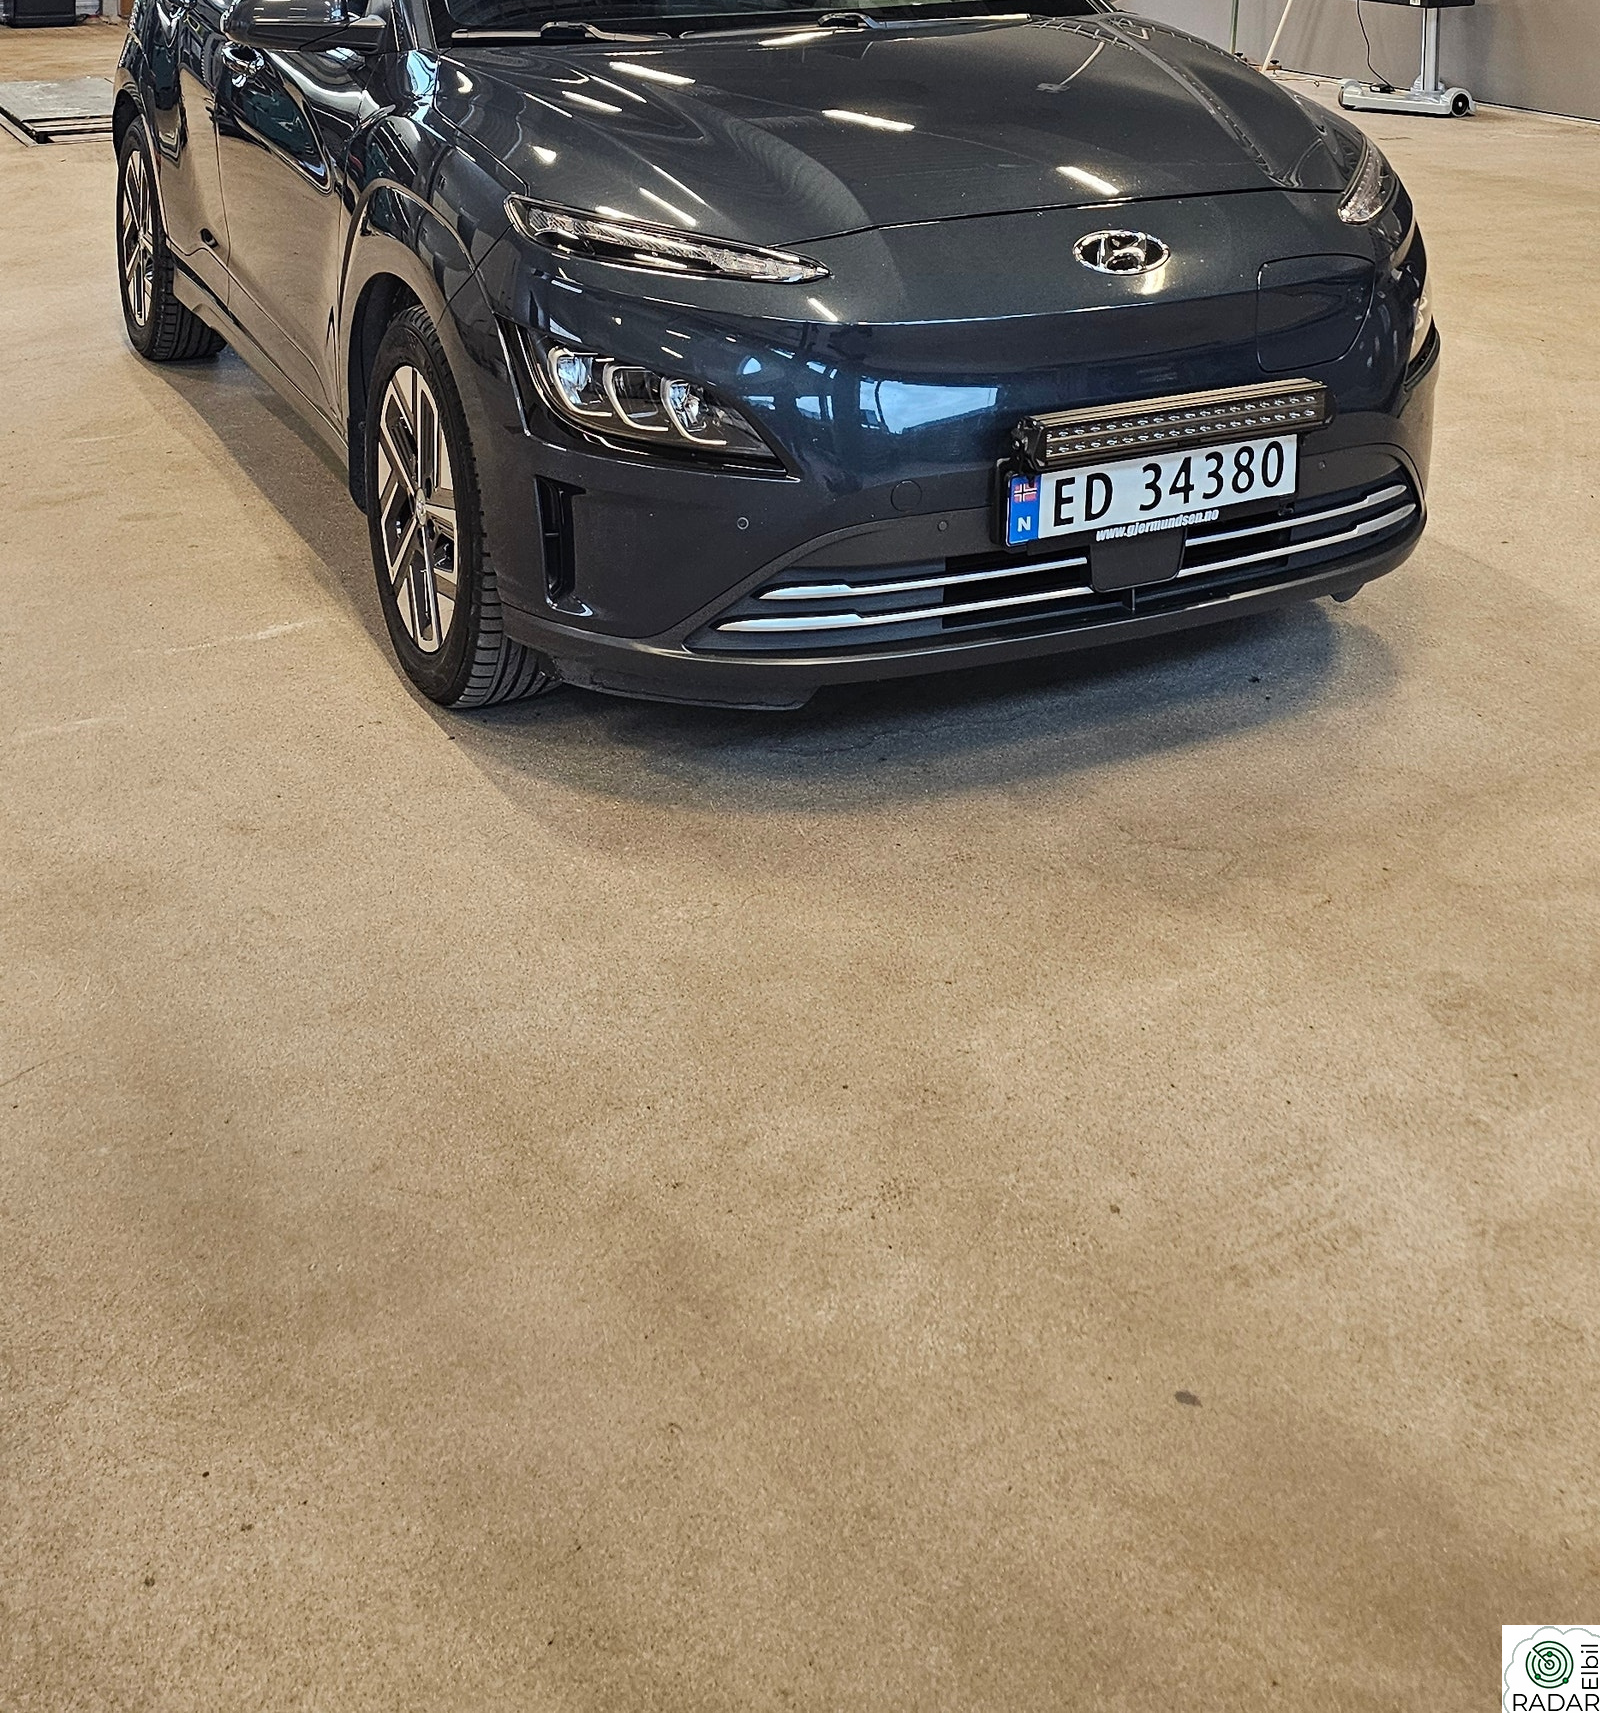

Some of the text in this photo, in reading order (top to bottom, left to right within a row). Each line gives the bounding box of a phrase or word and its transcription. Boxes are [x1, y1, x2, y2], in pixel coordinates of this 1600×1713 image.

[1053, 440, 1285, 527] ED 34380
[1017, 517, 1032, 533] N
[1096, 509, 1220, 542] www.gjermundsen.no
